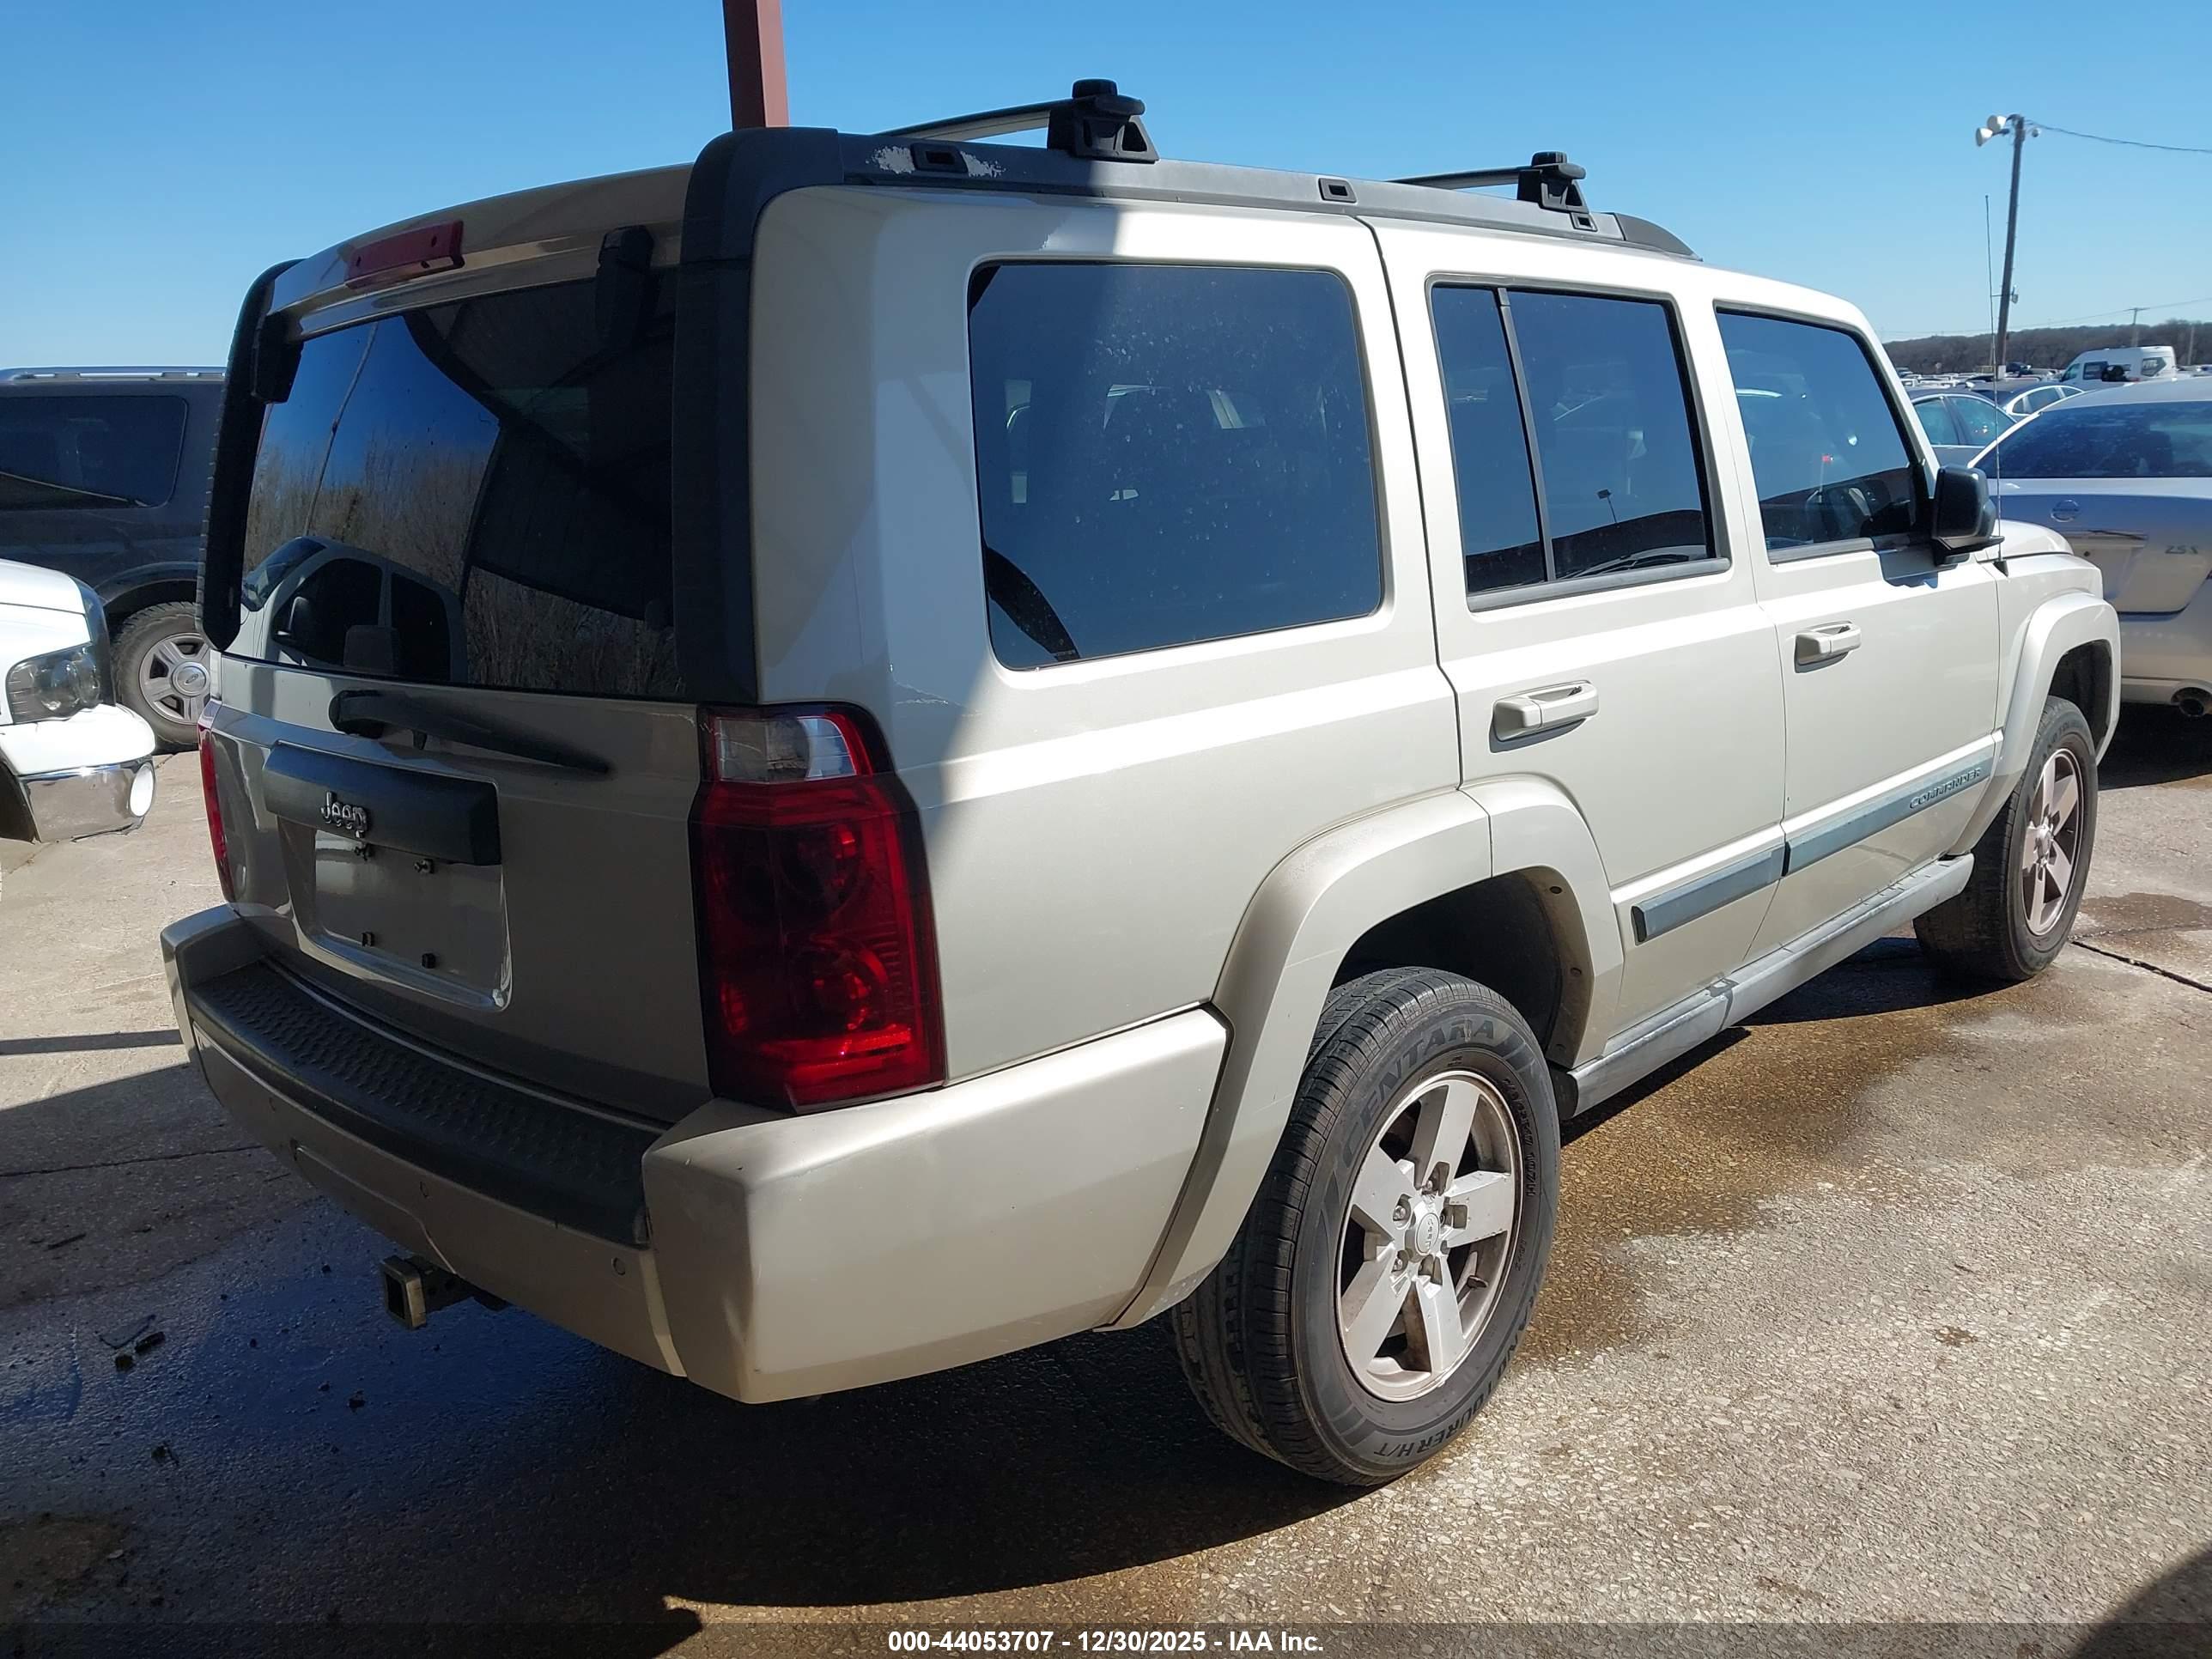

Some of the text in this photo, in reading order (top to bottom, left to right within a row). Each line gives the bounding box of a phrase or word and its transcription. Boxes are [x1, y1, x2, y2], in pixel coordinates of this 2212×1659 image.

[1909, 767, 1983, 809] COMMANDER
[320, 791, 368, 839] Jeep
[1341, 1019, 1495, 1169] CENTARA
[1373, 1442, 1415, 1457] H/T
